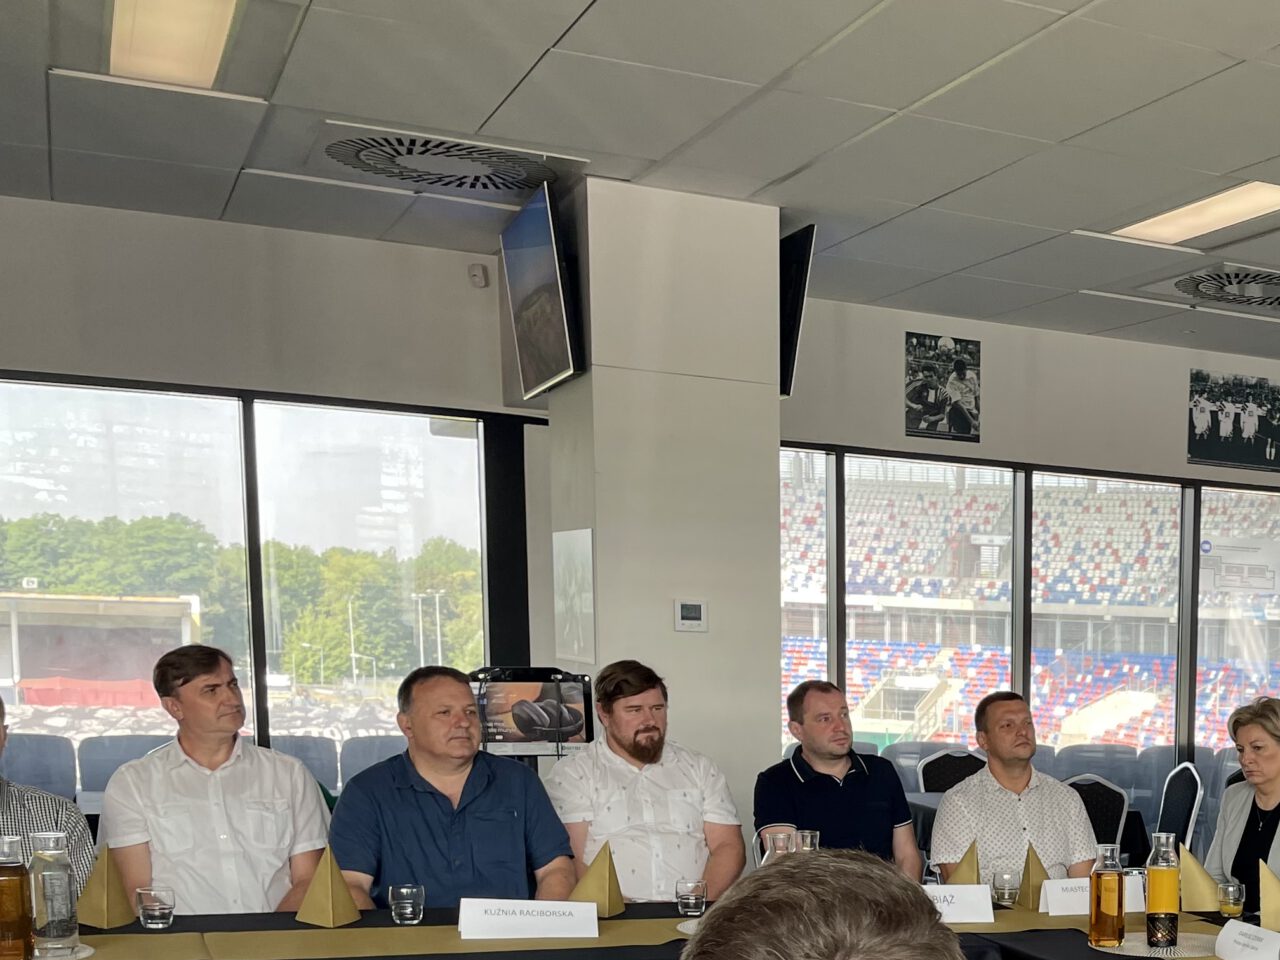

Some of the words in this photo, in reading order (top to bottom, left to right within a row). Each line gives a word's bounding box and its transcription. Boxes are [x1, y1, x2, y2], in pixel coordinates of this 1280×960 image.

[932, 894, 955, 906] BIĄŻ
[484, 908, 517, 917] KUŹNIA
[519, 909, 574, 918] RACIBORSKA
